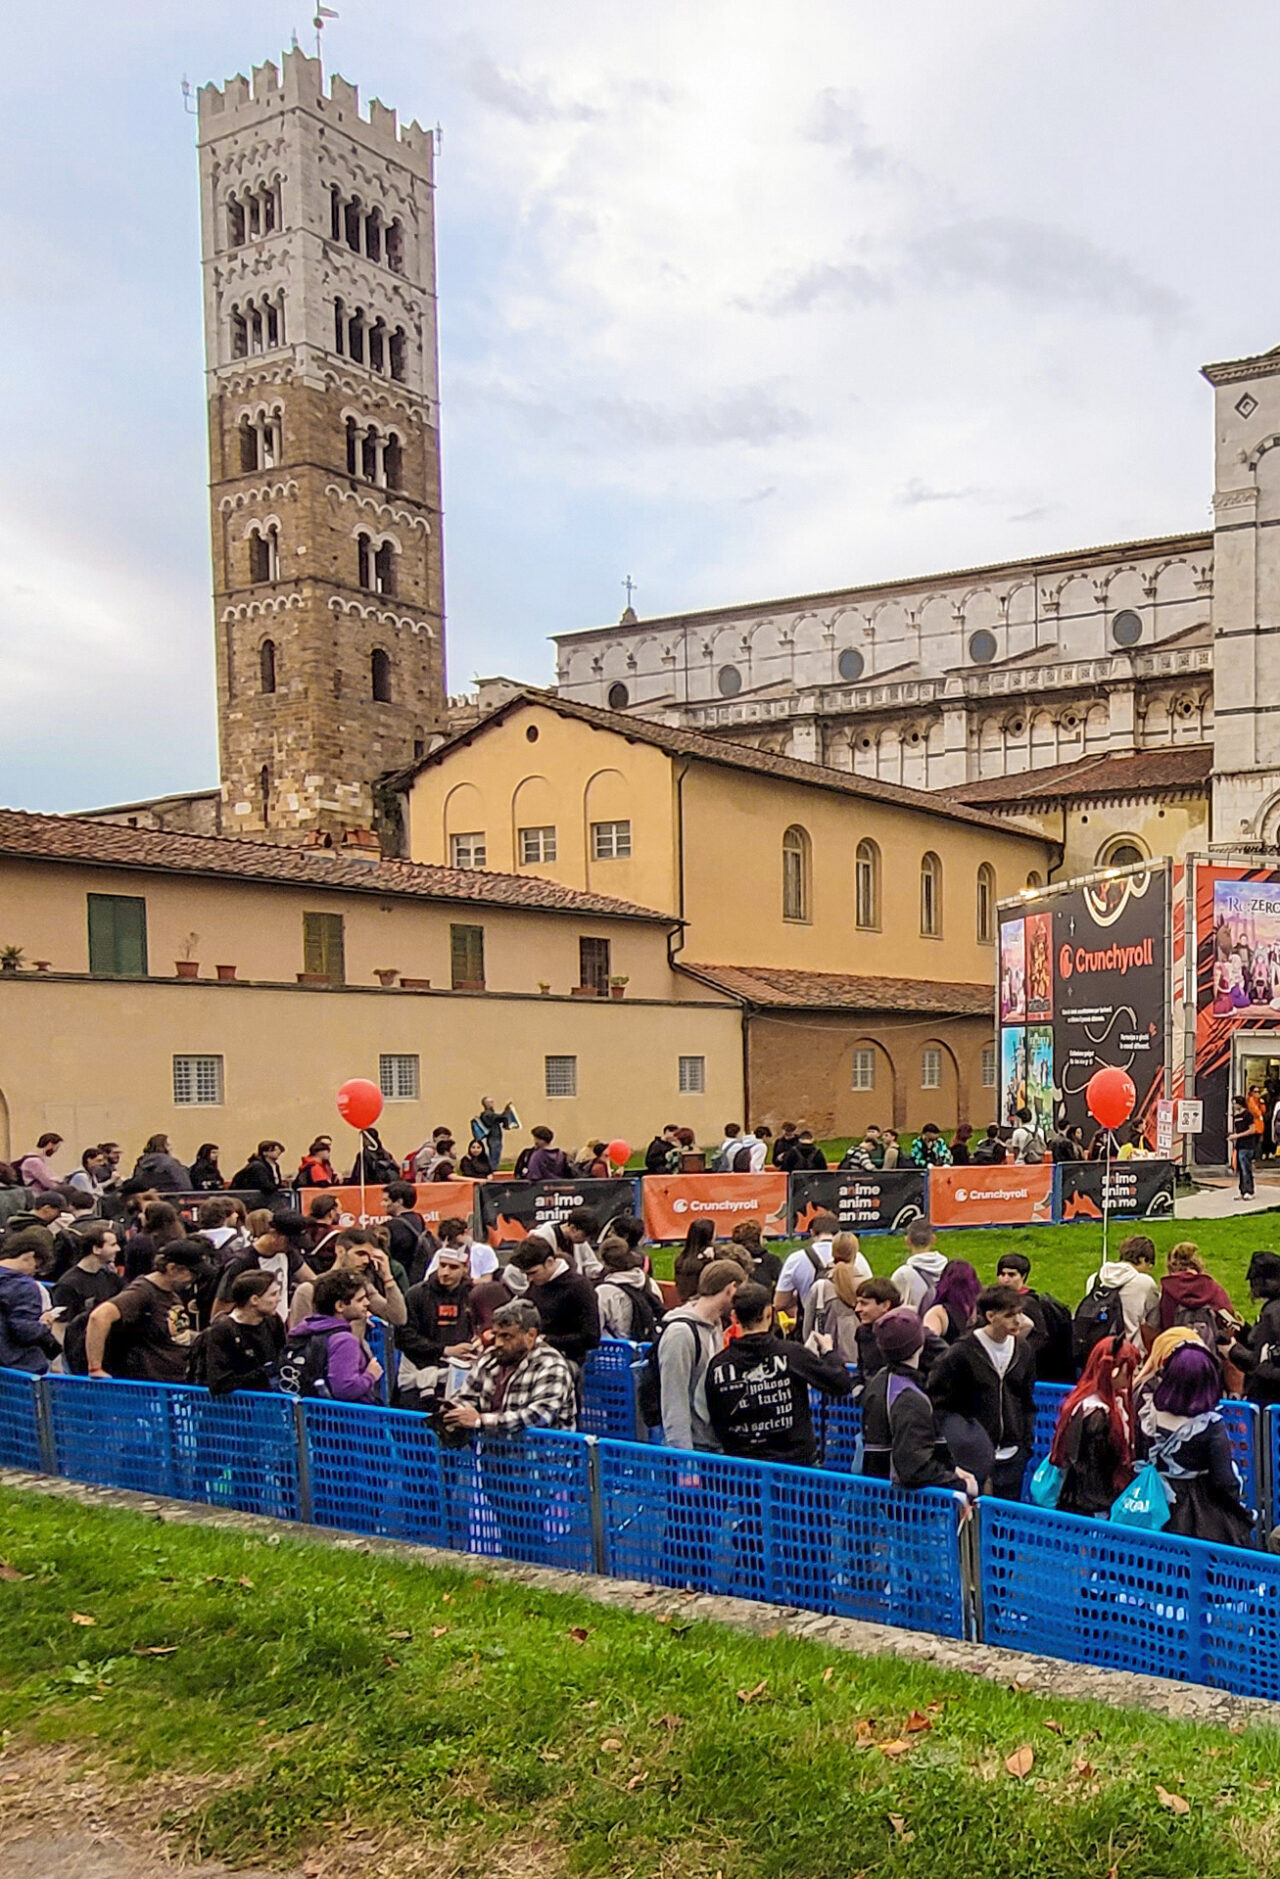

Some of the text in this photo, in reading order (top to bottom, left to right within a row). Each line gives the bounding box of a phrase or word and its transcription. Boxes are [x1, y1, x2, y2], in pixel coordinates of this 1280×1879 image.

[1075, 938, 1153, 975] Crunchyroll
[839, 1183, 881, 1196] anime
[970, 1188, 1028, 1200] Crunchyroll
[535, 1192, 584, 1207] anime
[690, 1199, 759, 1212] Crunchyroll
[358, 1210, 440, 1226] Crunoll
[535, 1207, 574, 1220] anim
[838, 1209, 881, 1222] anme
